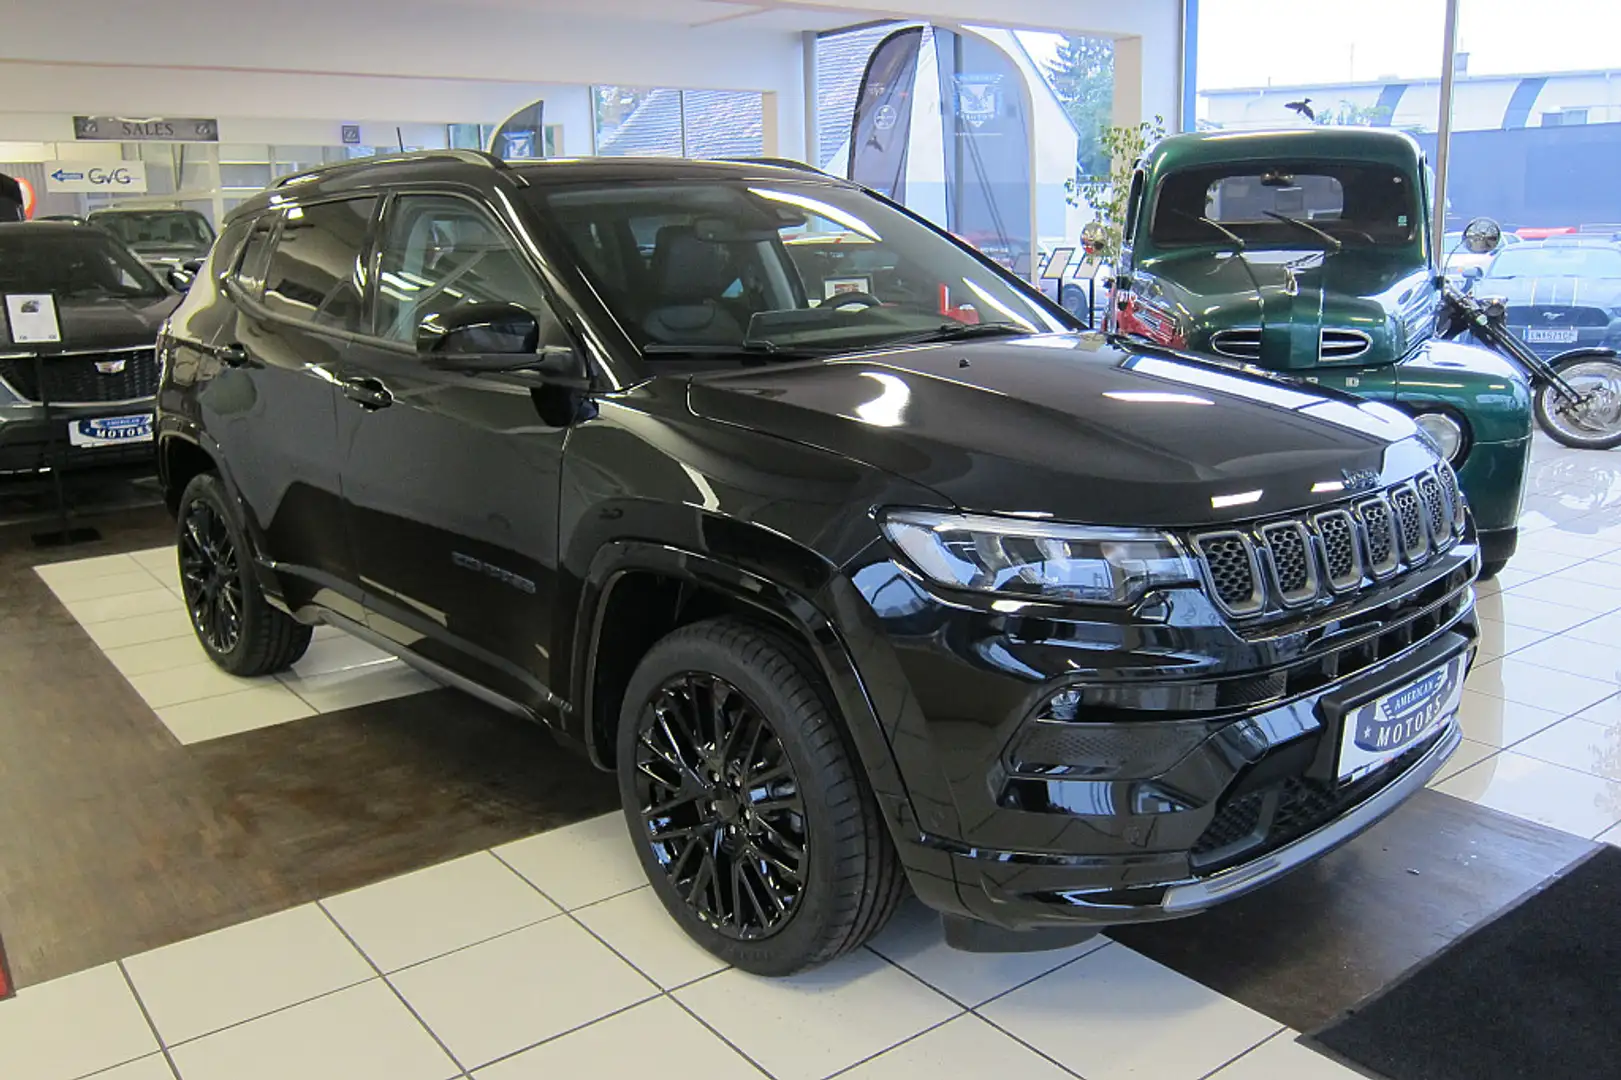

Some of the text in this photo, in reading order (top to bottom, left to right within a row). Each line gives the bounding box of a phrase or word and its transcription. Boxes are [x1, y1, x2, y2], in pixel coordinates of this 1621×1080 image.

[122, 122, 175, 136] SALES
[1394, 679, 1435, 710] AMERICAN
[1377, 694, 1442, 747] MOTORS
